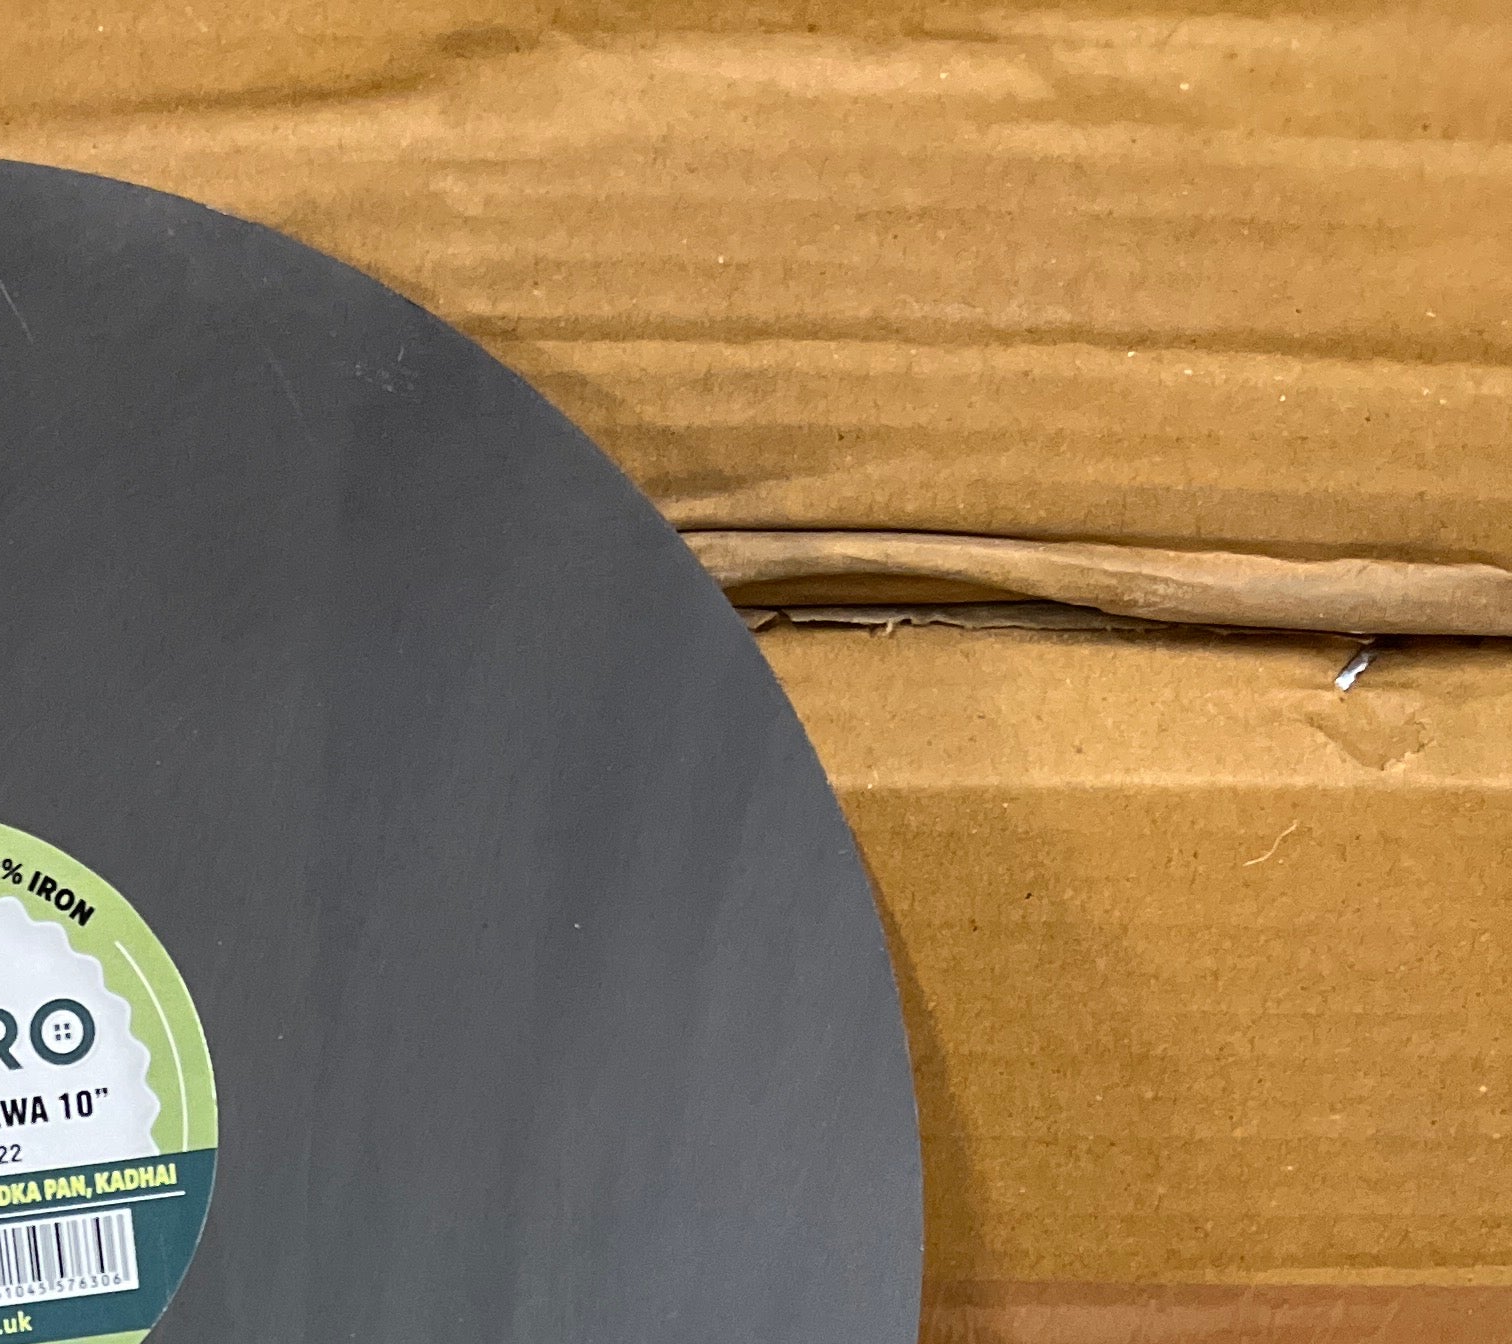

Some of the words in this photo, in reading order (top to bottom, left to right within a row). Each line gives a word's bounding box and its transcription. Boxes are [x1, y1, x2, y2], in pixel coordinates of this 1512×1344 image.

[27, 870, 95, 927] IRON
[44, 1175, 92, 1200] PAN,
[94, 1163, 178, 1194] KADHAI
